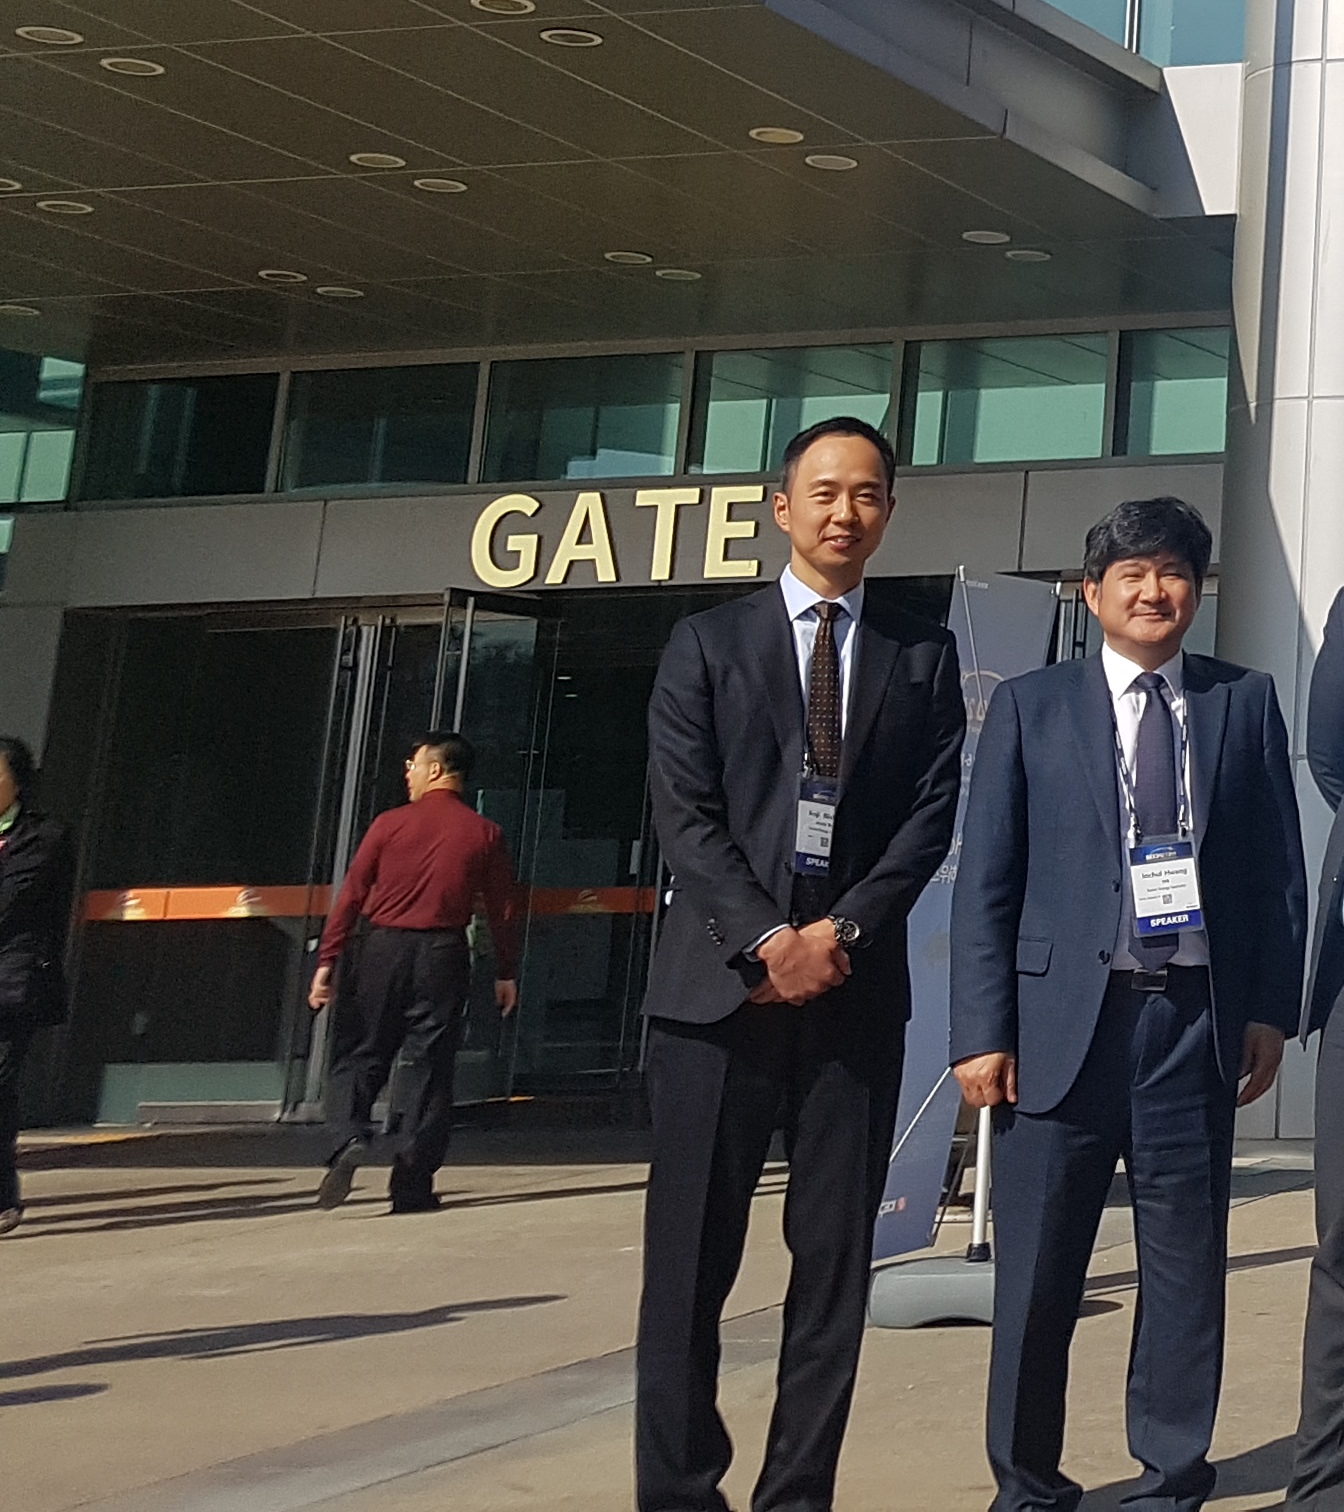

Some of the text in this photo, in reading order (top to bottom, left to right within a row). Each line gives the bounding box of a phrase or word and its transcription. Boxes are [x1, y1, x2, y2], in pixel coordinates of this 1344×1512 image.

[470, 485, 764, 588] GATE
[805, 857, 830, 868] SPEAK
[1149, 914, 1189, 928] SPEAKER
